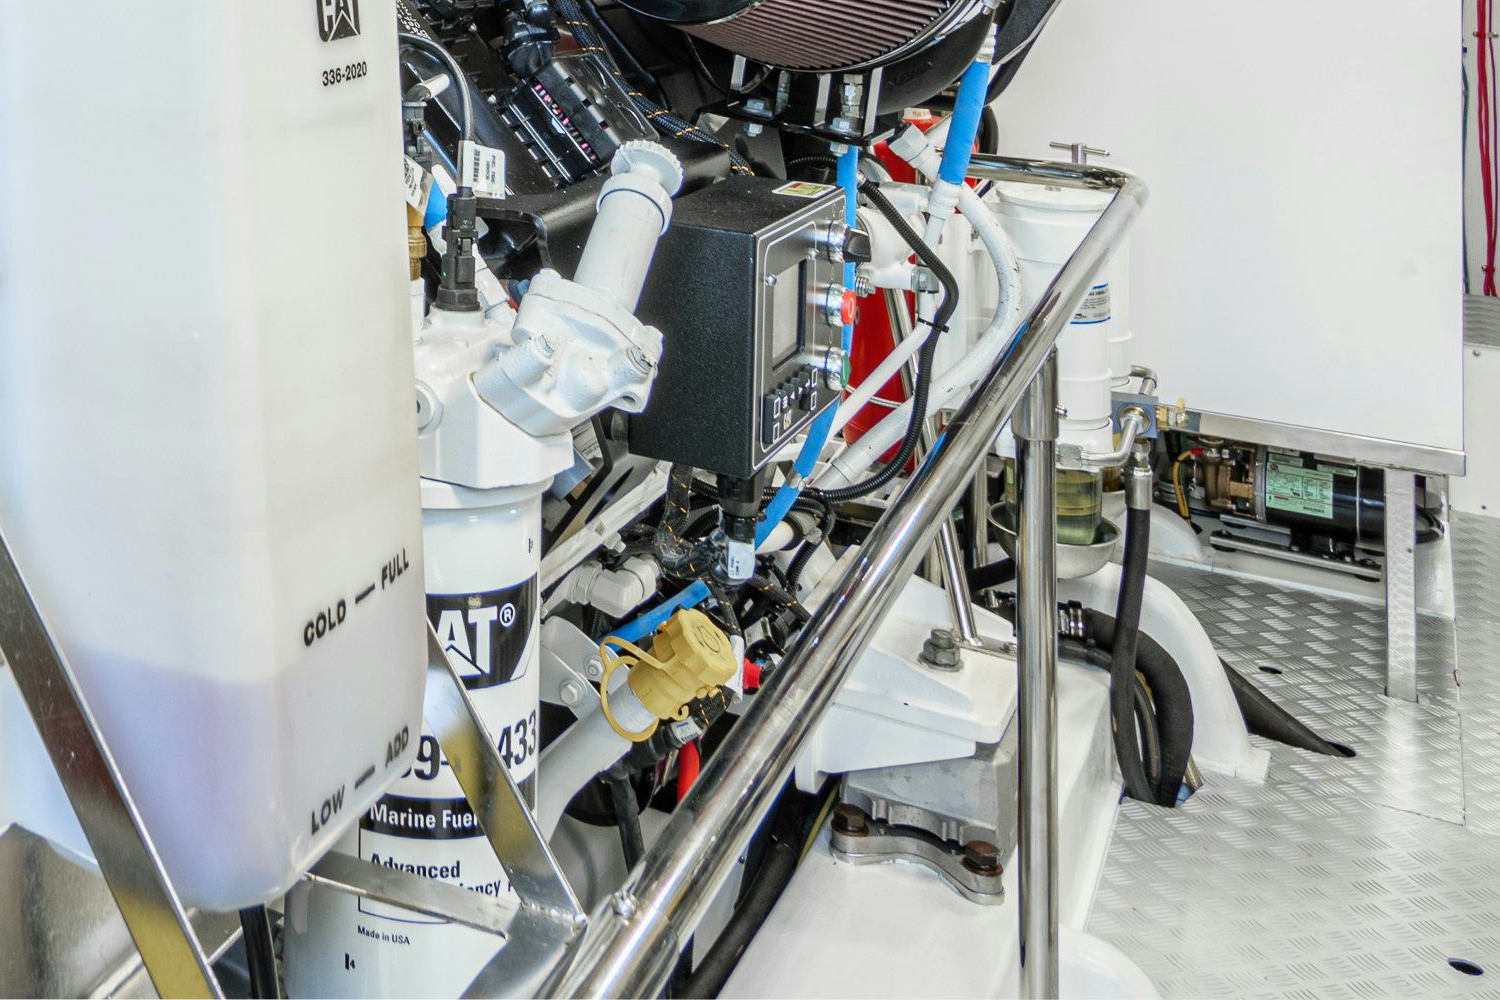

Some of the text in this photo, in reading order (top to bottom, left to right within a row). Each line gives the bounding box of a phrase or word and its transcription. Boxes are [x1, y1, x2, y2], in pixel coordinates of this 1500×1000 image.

[322, 61, 367, 87] 336-2020
[303, 547, 409, 647] COLD FULL
[311, 725, 409, 836] LOW ADD
[370, 803, 436, 829] Marine
[357, 925, 410, 945] Made in USA
